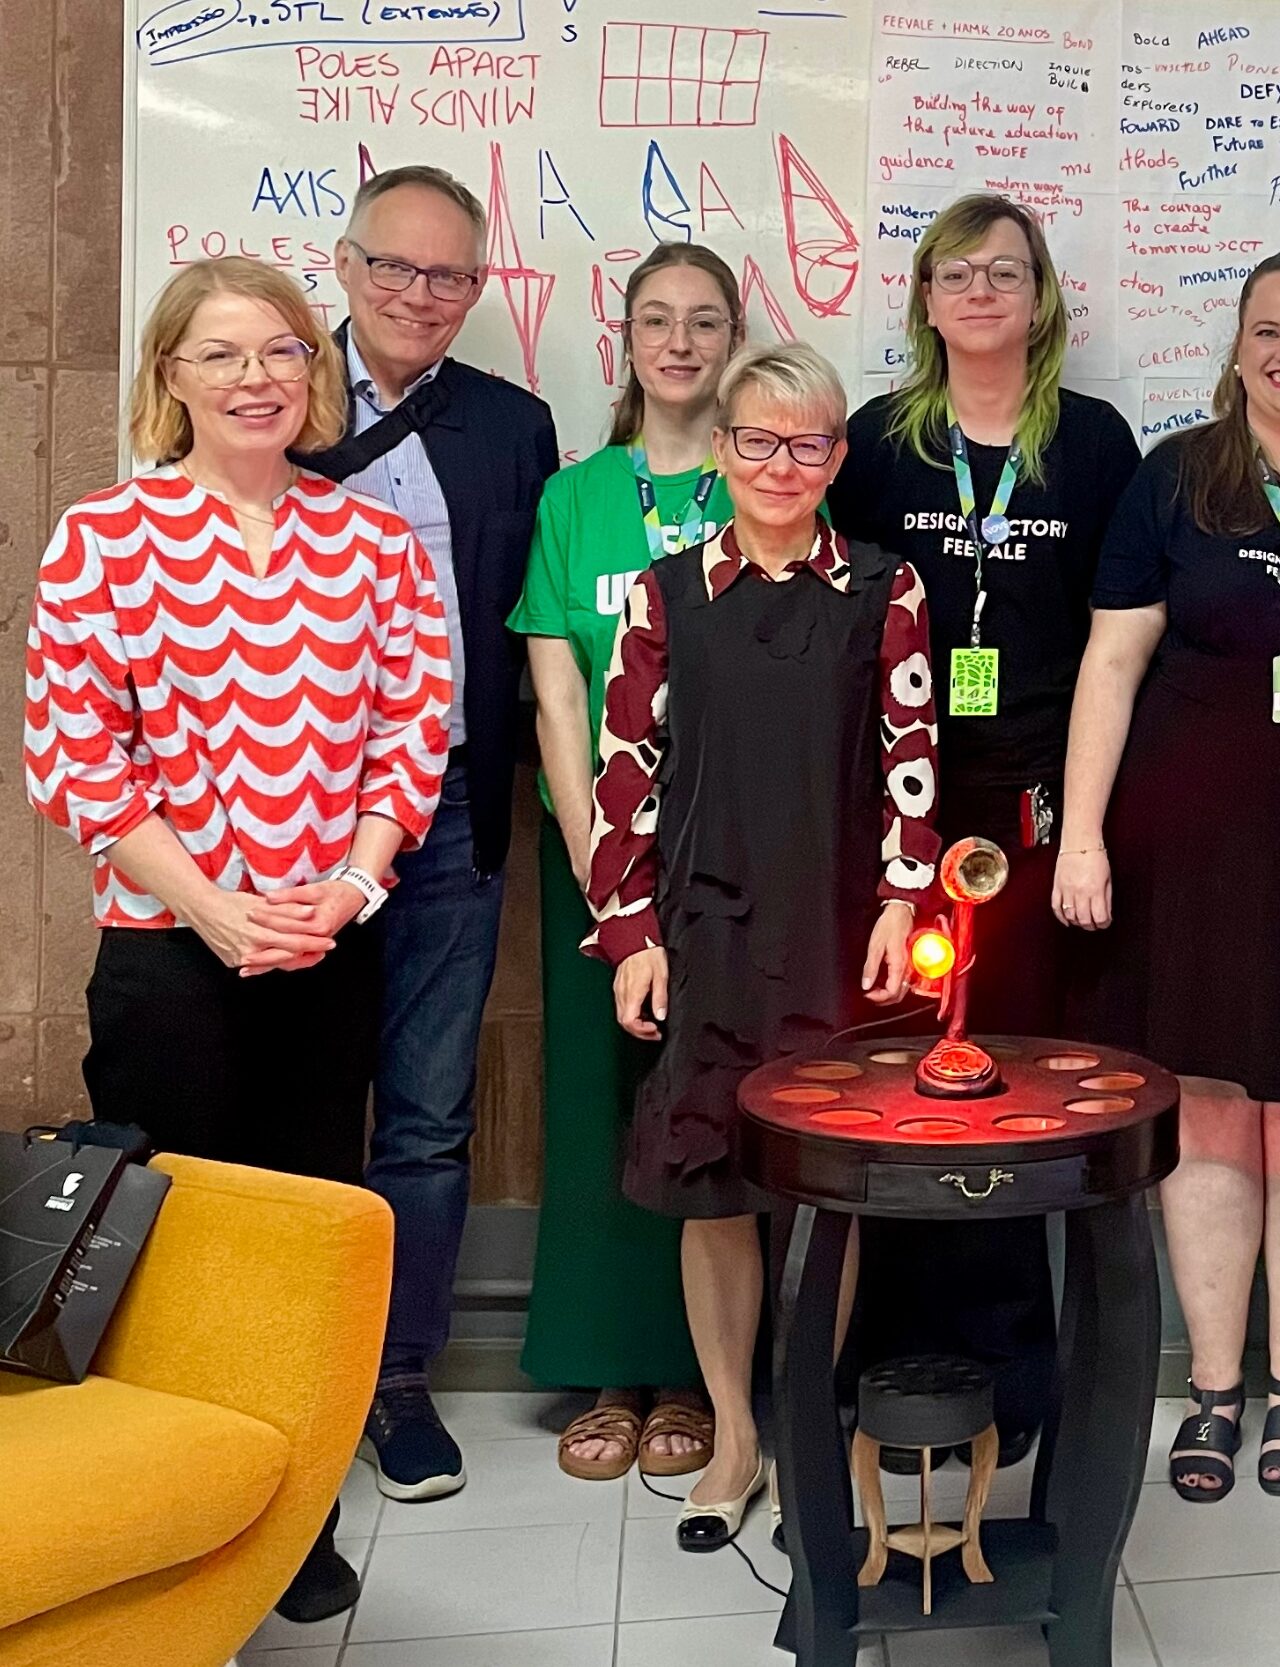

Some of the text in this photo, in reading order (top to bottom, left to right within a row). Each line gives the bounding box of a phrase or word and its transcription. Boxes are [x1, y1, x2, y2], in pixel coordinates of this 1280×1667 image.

[883, 15, 934, 30] FEEVALE
[953, 23, 990, 36] HAMK
[998, 26, 1015, 38] 20
[1198, 26, 1250, 49] AHEAD
[296, 46, 541, 81] POLES APART
[886, 56, 930, 72] REBEL
[955, 57, 1023, 71] DIRECTION
[297, 84, 533, 131] MINDS ALIKE
[1008, 103, 1035, 120] way
[1047, 106, 1065, 124] of
[944, 122, 996, 146] future
[1005, 123, 1078, 141] education
[1206, 116, 1242, 130] DARE
[880, 148, 955, 180] guidance
[252, 167, 346, 216] AXIS
[882, 204, 939, 219] wildern
[1123, 224, 1141, 235] to
[1203, 297, 1239, 312] EVOLV
[1142, 409, 1209, 435] RONTIER
[944, 537, 1026, 560] FEEALE
